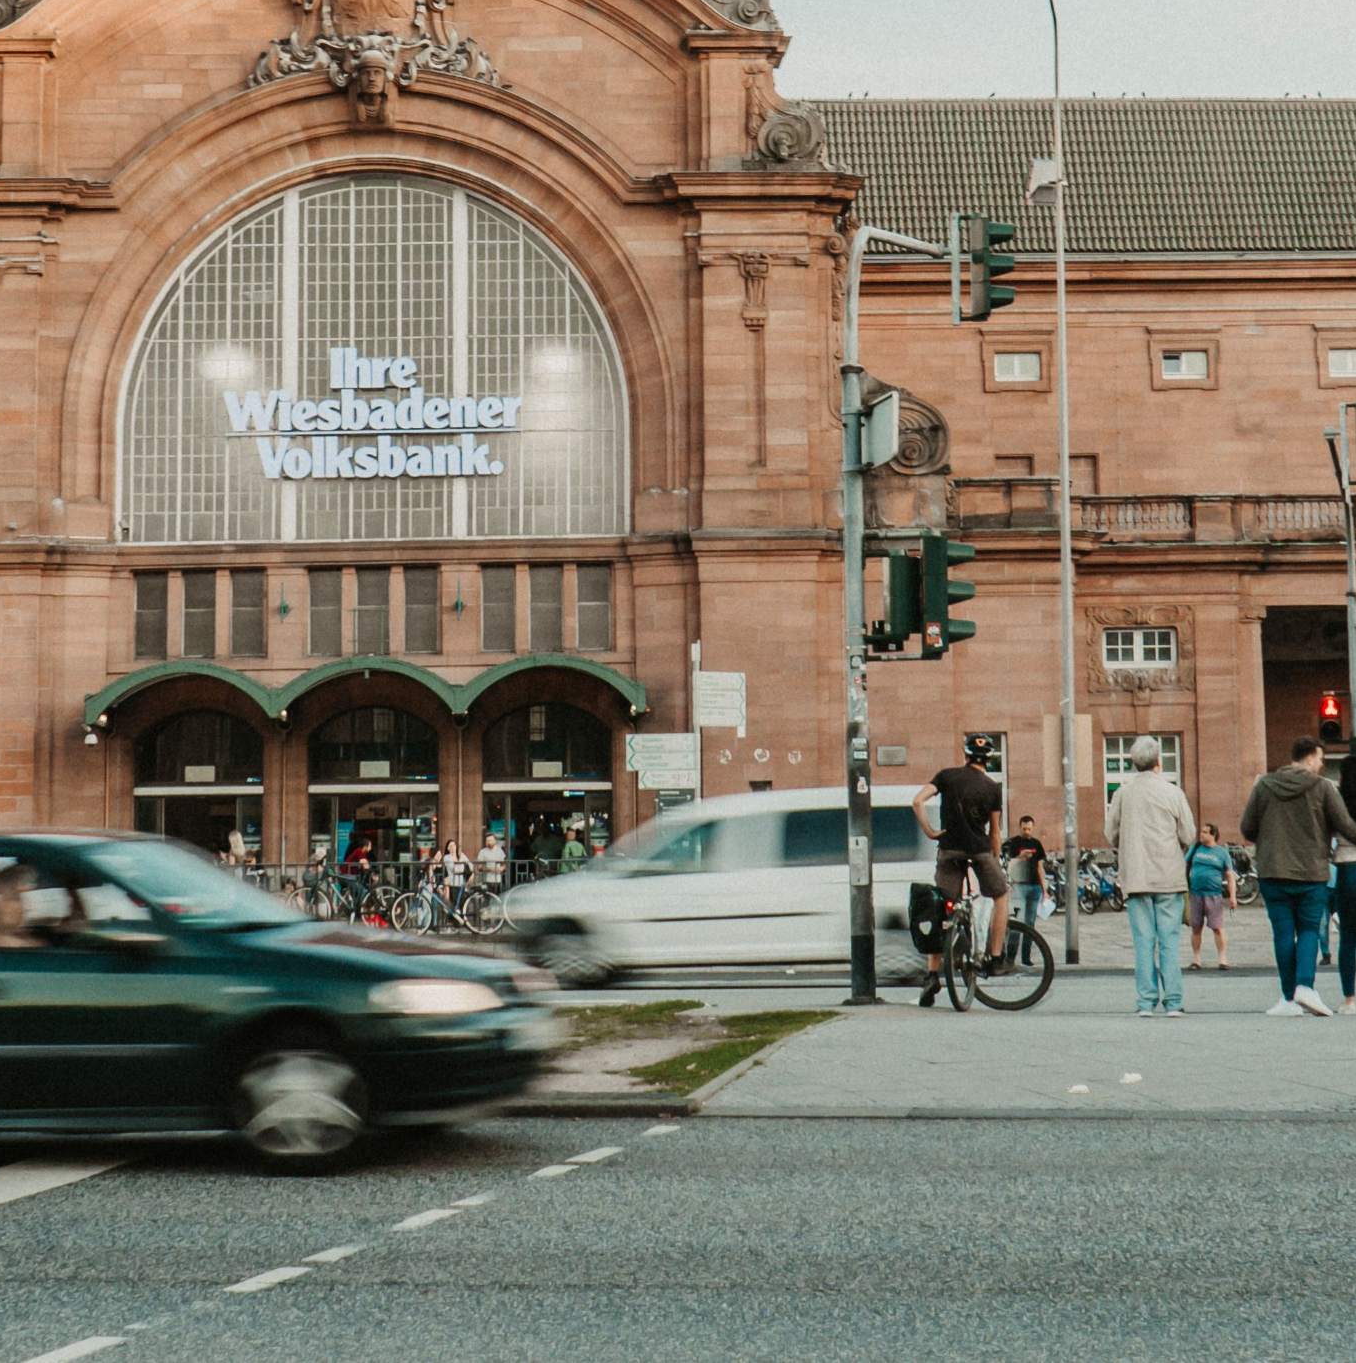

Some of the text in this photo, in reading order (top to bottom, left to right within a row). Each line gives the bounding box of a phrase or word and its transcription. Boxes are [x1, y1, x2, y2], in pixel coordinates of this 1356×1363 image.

[329, 347, 417, 390] Ihre
[223, 388, 522, 432] Wiesbadener
[256, 433, 504, 479] Volksbank.
